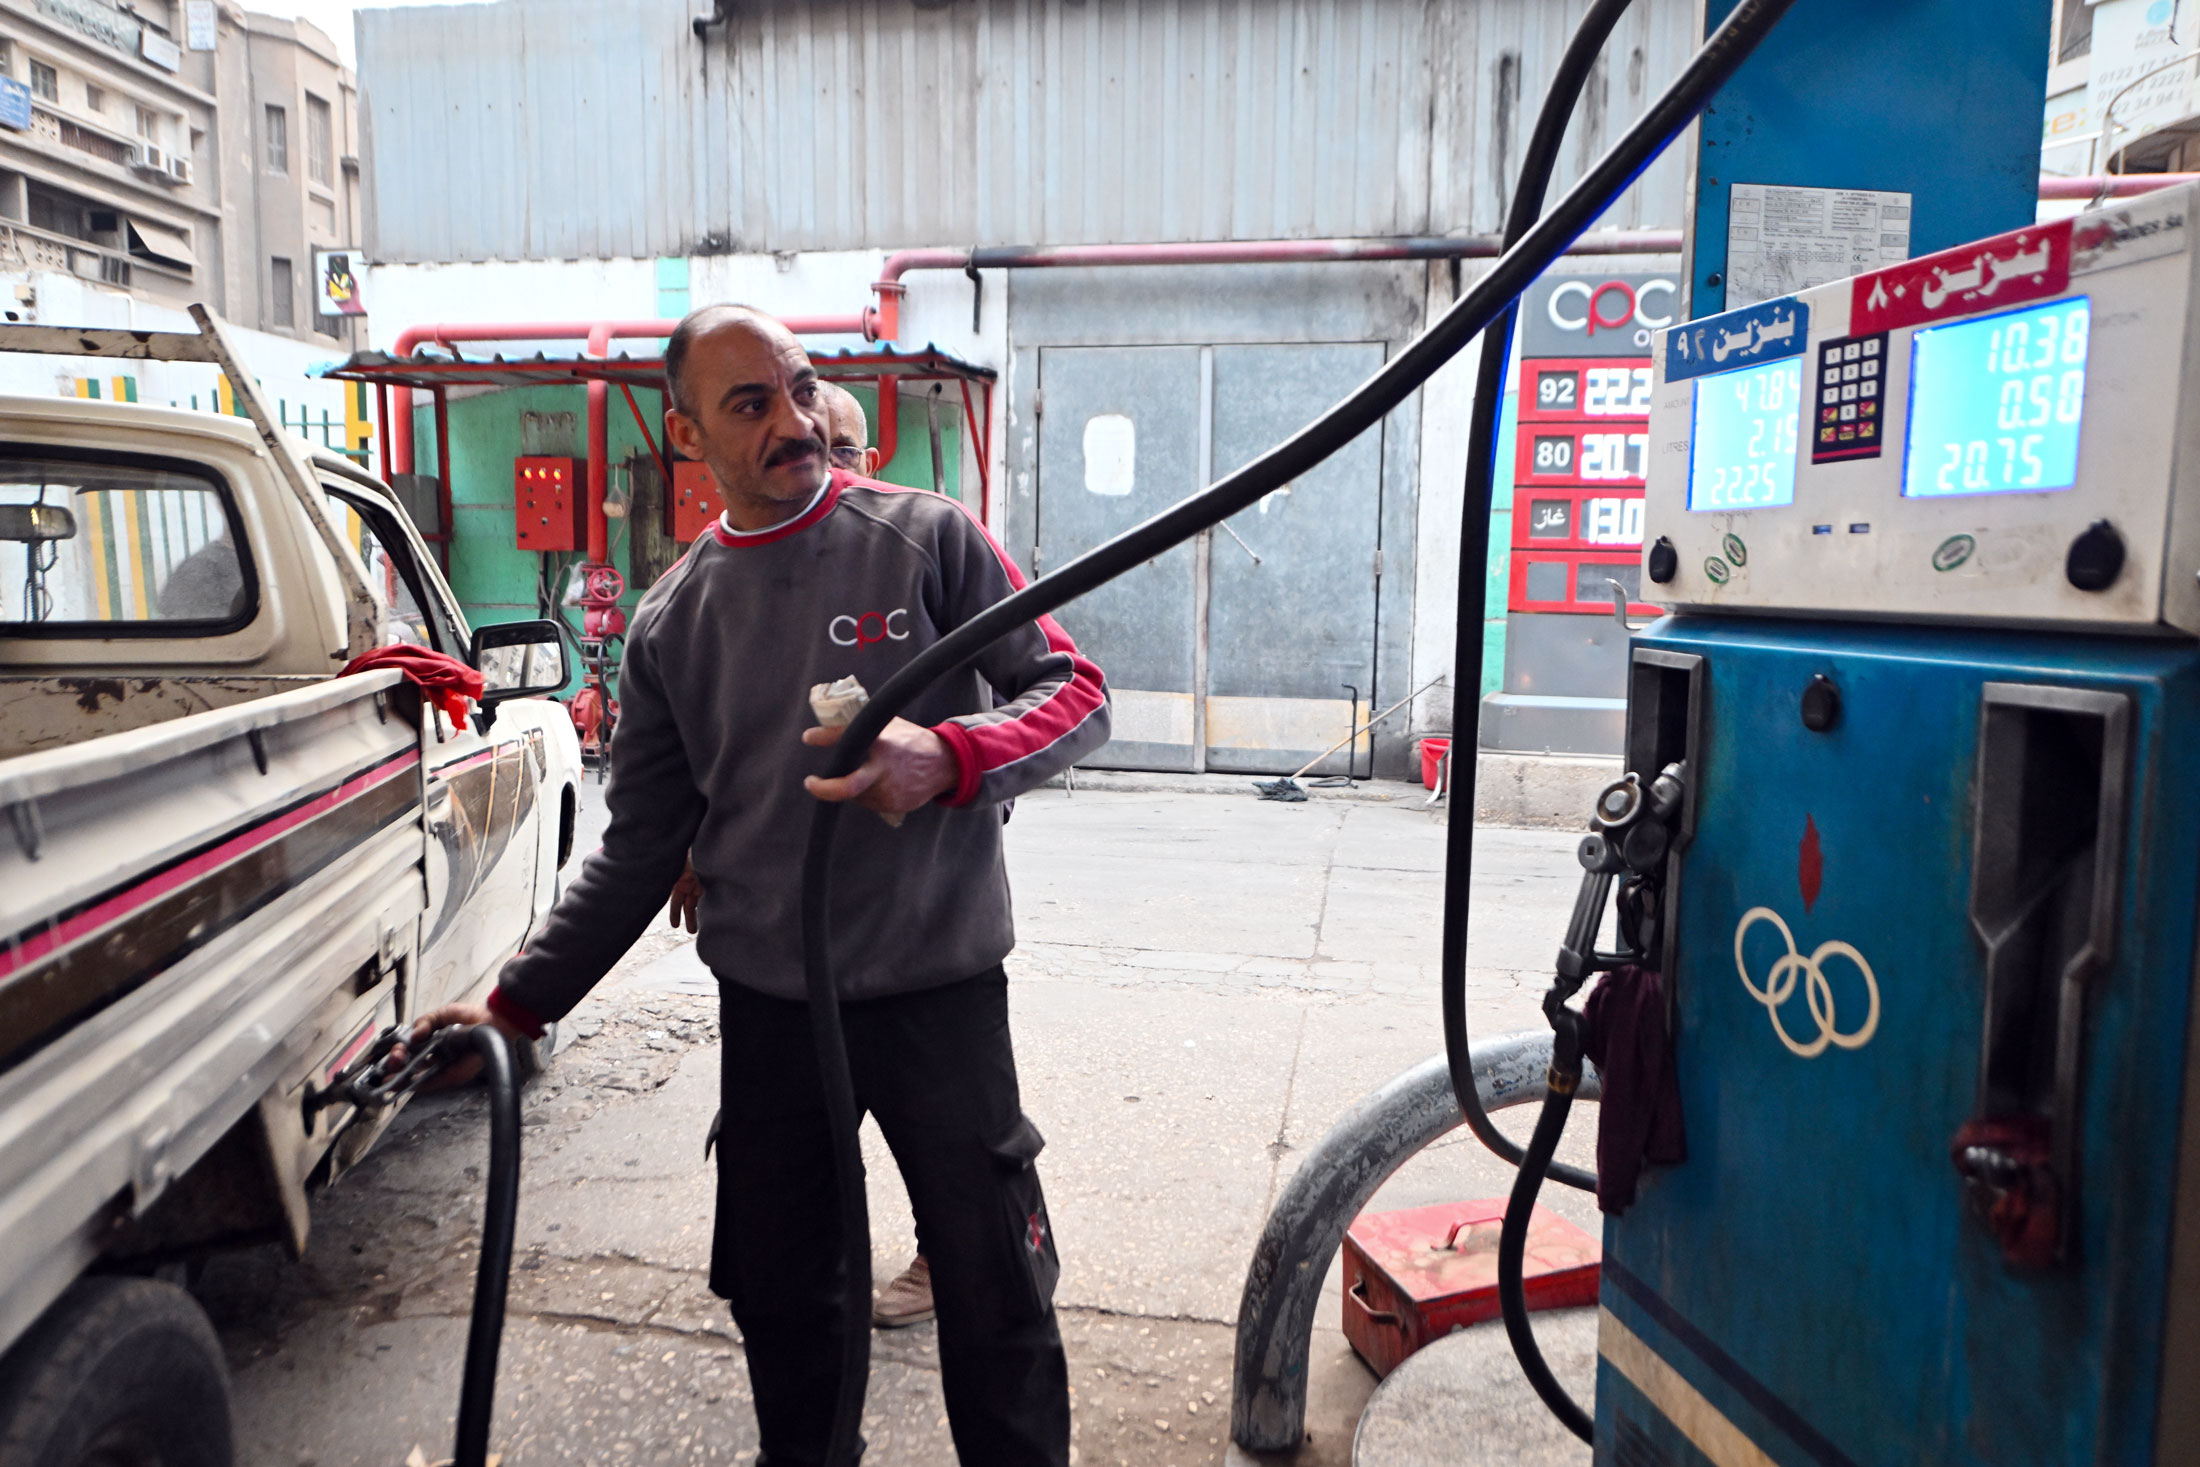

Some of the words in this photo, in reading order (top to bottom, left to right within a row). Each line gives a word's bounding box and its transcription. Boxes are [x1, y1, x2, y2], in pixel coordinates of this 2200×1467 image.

[1867, 275, 1906, 312] ٨٠
[1922, 236, 2051, 309] بنزين
[1677, 328, 1706, 360] ٩٢
[1712, 306, 1795, 362] بنزين
[1988, 309, 2089, 373] 10.38
[1539, 378, 1575, 403] 92
[1998, 369, 2085, 430] 0.50
[1537, 442, 1571, 467] 80
[1748, 413, 1798, 457] 2.15
[1712, 462, 1776, 504] 22.25
[1937, 434, 2044, 490] 20.75
[1533, 508, 1566, 529] غاز
